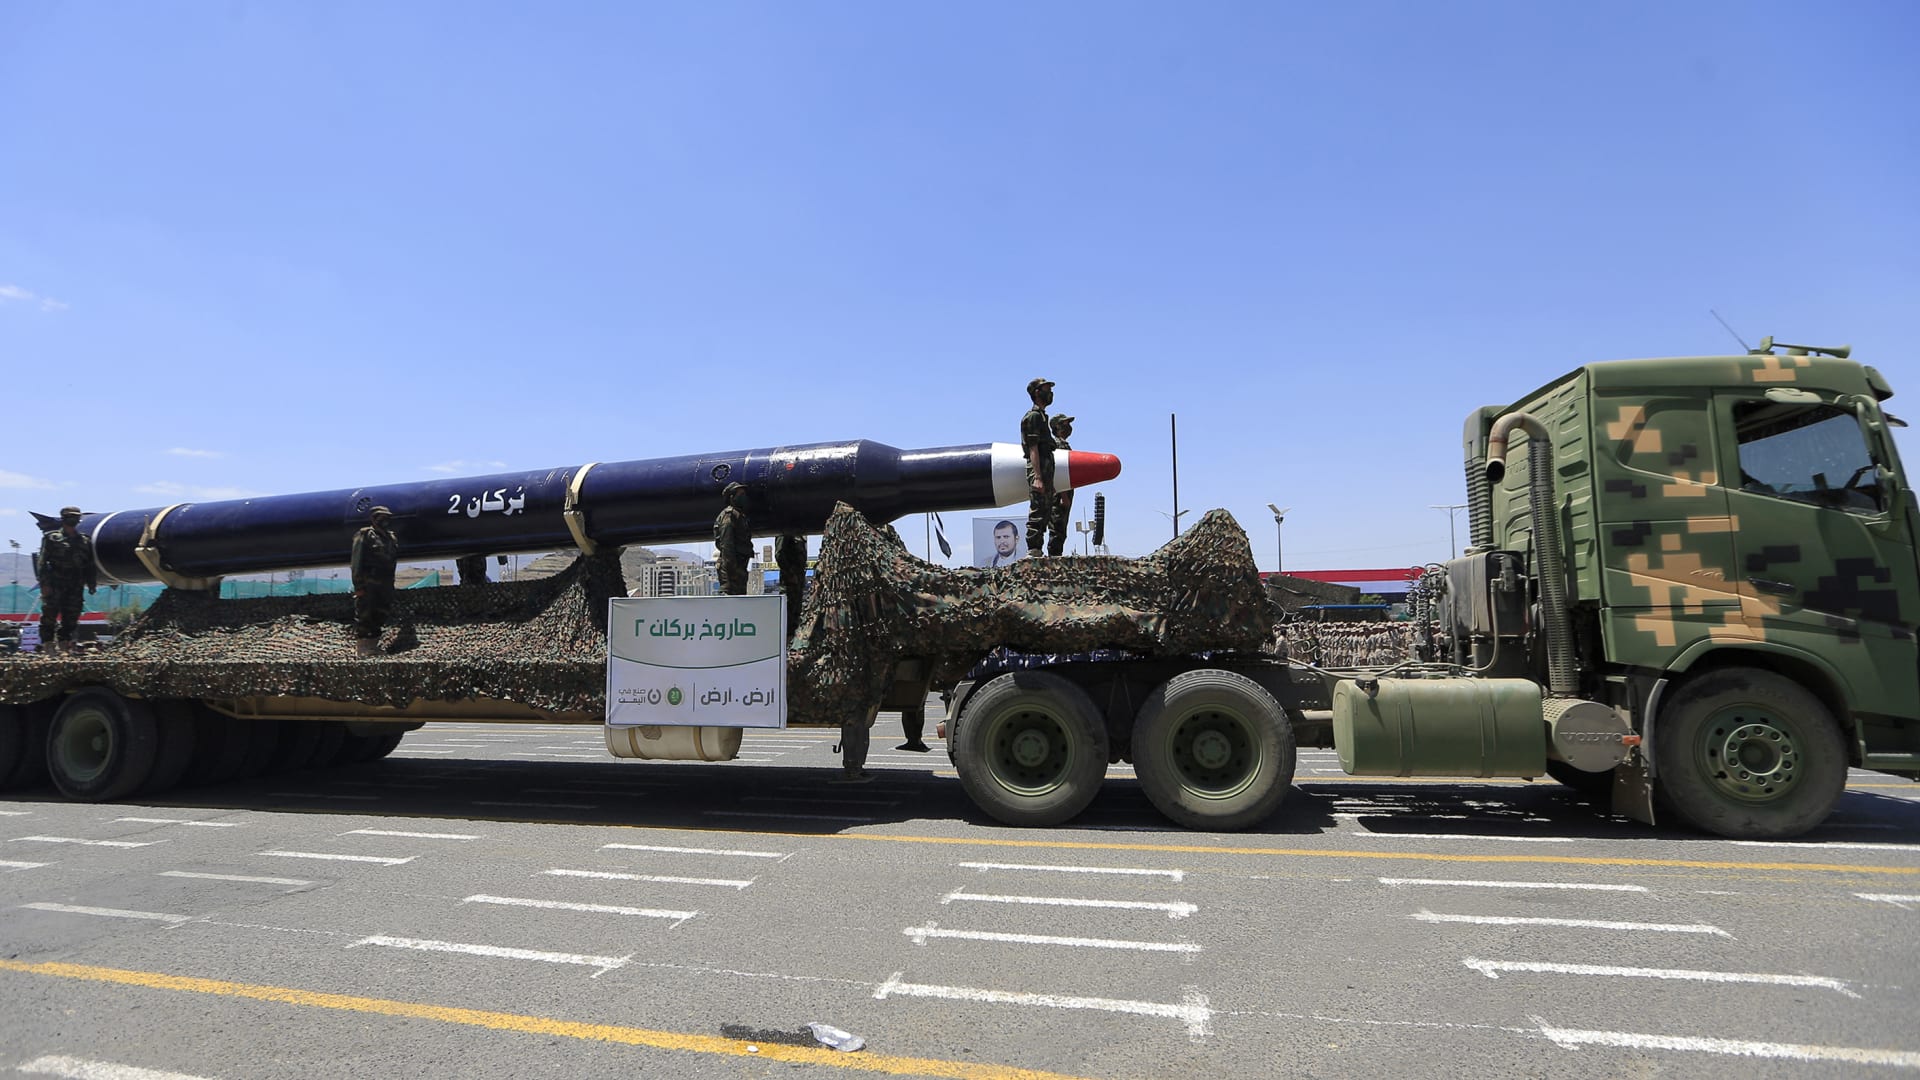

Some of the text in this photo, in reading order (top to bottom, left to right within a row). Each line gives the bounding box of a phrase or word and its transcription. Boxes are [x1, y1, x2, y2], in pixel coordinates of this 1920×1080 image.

[447, 494, 461, 514] 2
[650, 619, 695, 641] بركان
[699, 618, 756, 641] صاروخ
